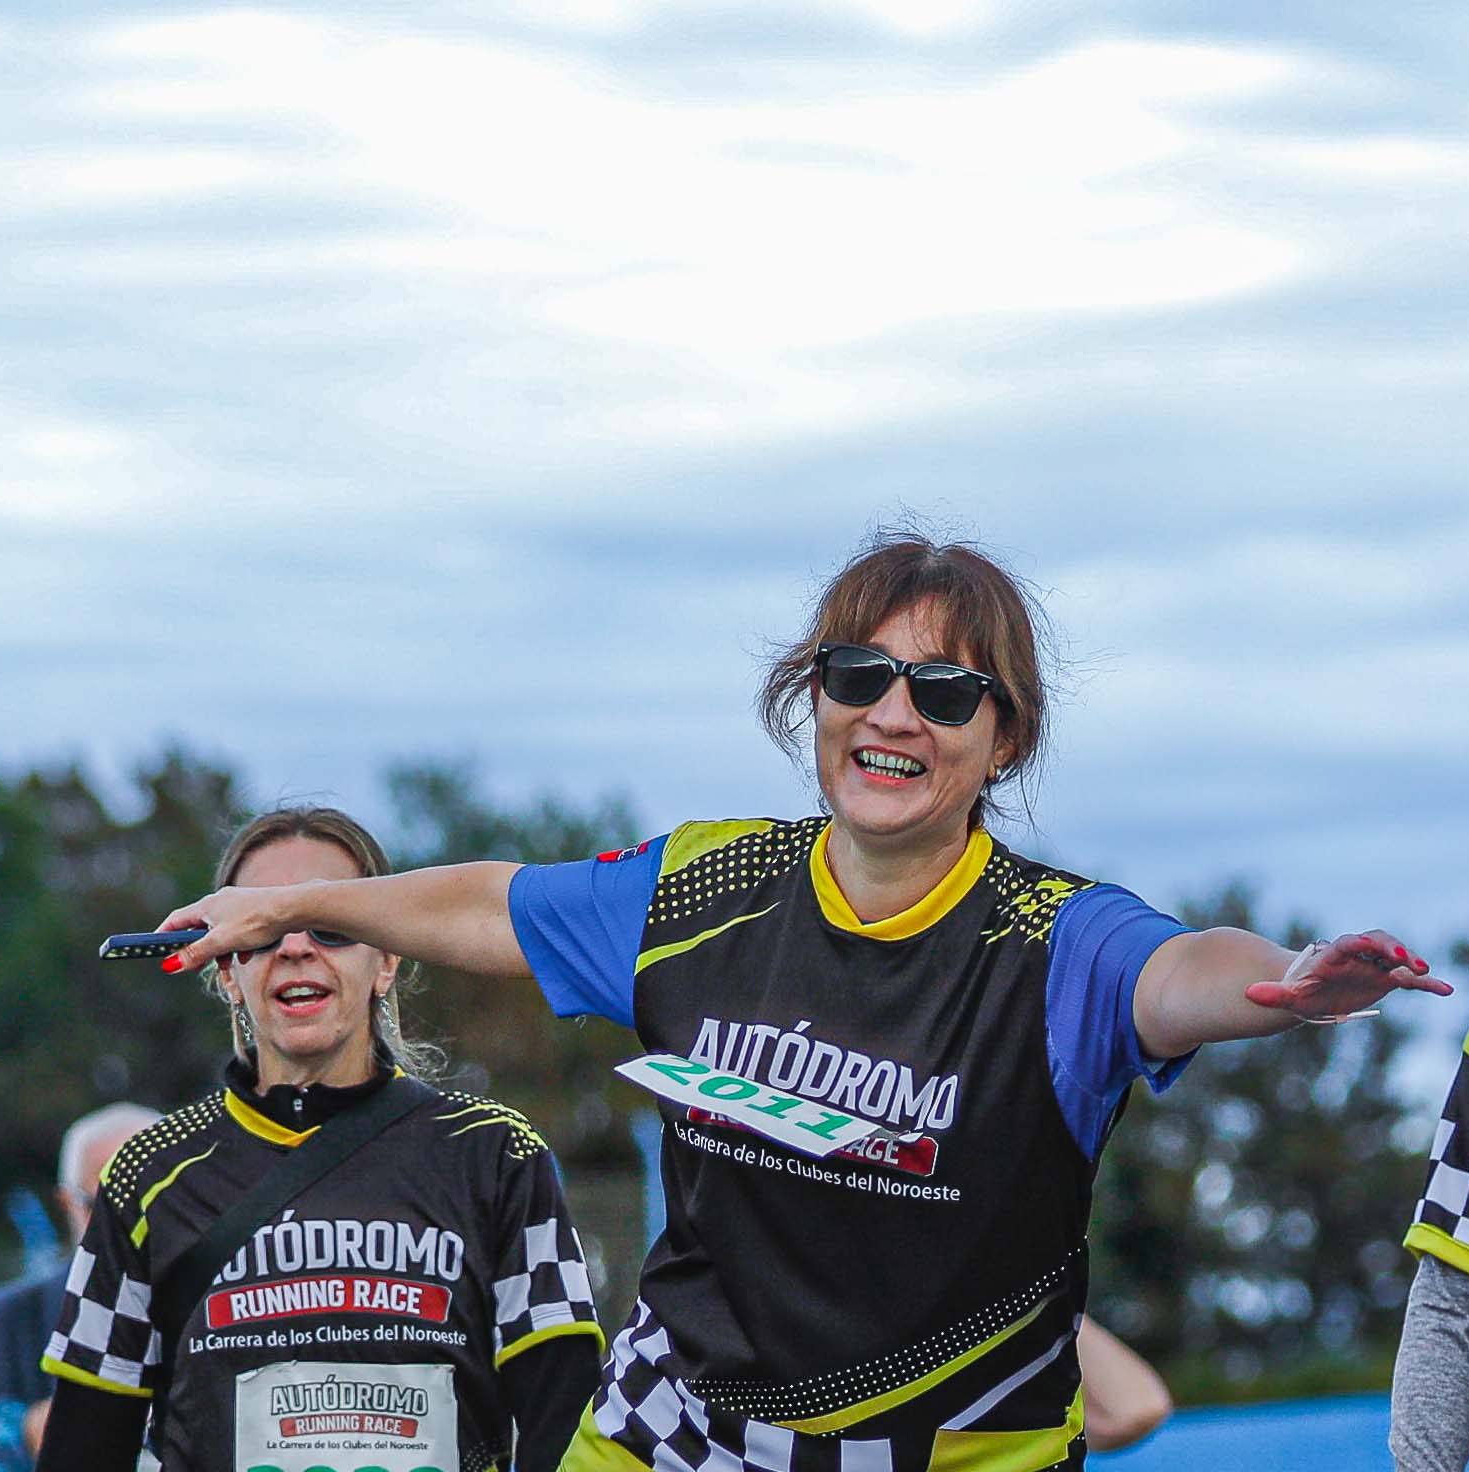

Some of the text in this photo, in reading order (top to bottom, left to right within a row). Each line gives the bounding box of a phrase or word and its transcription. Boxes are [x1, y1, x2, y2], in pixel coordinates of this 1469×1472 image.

[688, 1017, 959, 1131] AUTÓDROMO
[645, 1056, 855, 1141] 2011
[674, 1121, 962, 1201] La Carrera de los Clubes del Noroeste
[230, 1280, 423, 1321] RUNNING RACE
[189, 1324, 468, 1354] La Carrera de los Clubes del Noroeste
[270, 1374, 429, 1416] AUTÓDROMO
[266, 1440, 278, 1449] La
[279, 1440, 312, 1449] Carrera
[313, 1439, 326, 1449] de
[327, 1440, 341, 1450] los
[375, 1440, 389, 1450] del
[295, 1415, 403, 1435] RUNNING RACE
